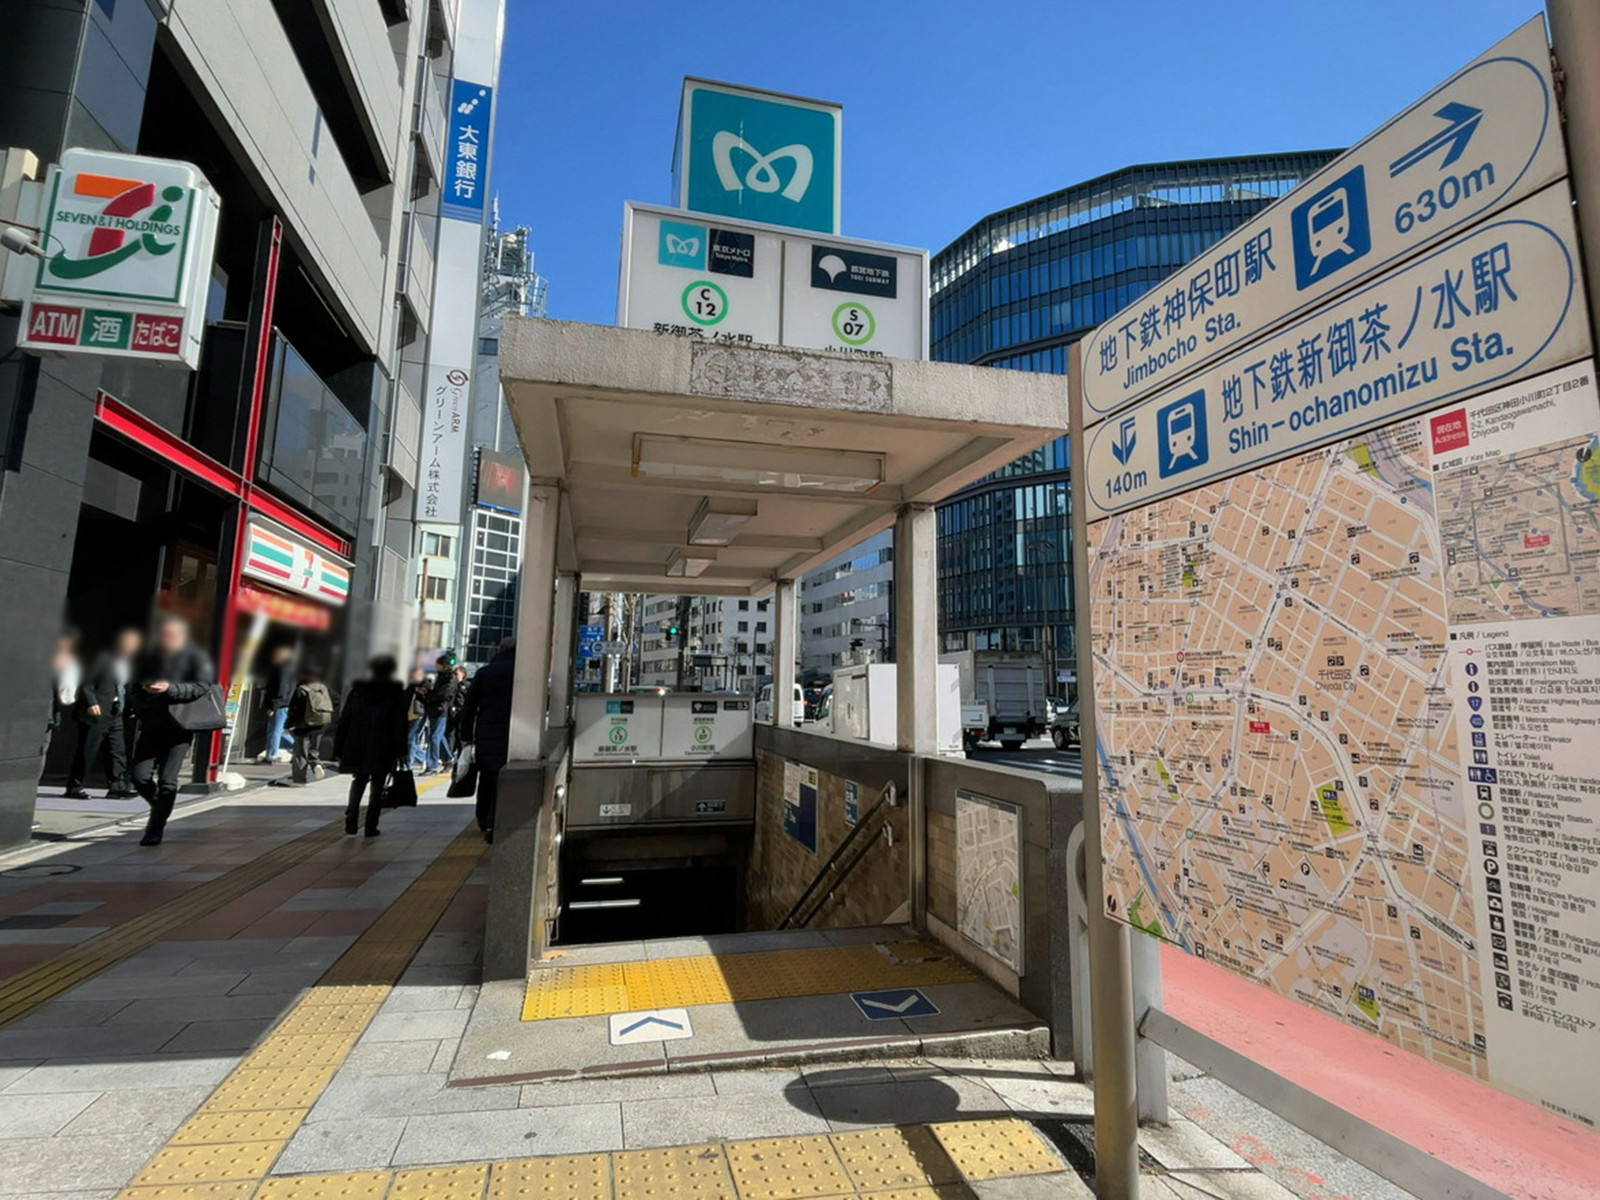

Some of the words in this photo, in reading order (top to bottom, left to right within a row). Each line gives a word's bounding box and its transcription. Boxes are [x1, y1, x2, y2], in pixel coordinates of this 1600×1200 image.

[454, 125, 480, 199] 大東銀行
[1395, 161, 1495, 234] 630m
[116, 217, 181, 236] HOLDINGS
[713, 245, 751, 257] 東京メトロ
[696, 301, 716, 316] 12
[700, 288, 710, 301] C
[1099, 228, 1277, 376] 地下鉄神保町駅
[31, 312, 78, 338] ATM
[90, 315, 123, 343] 酒
[843, 322, 864, 336] 07
[850, 309, 858, 321] S
[134, 321, 179, 348] たばこ
[1222, 243, 1518, 422] 地下鉄新御茶ノ水駅
[1122, 335, 1198, 390] Jimbocho
[1205, 311, 1242, 343] Sta.
[1229, 358, 1437, 453] Shin-ochanomizu
[1452, 330, 1514, 373] Sta.
[425, 385, 448, 517] グリーンアーム株式会社
[1105, 468, 1147, 499] 140m
